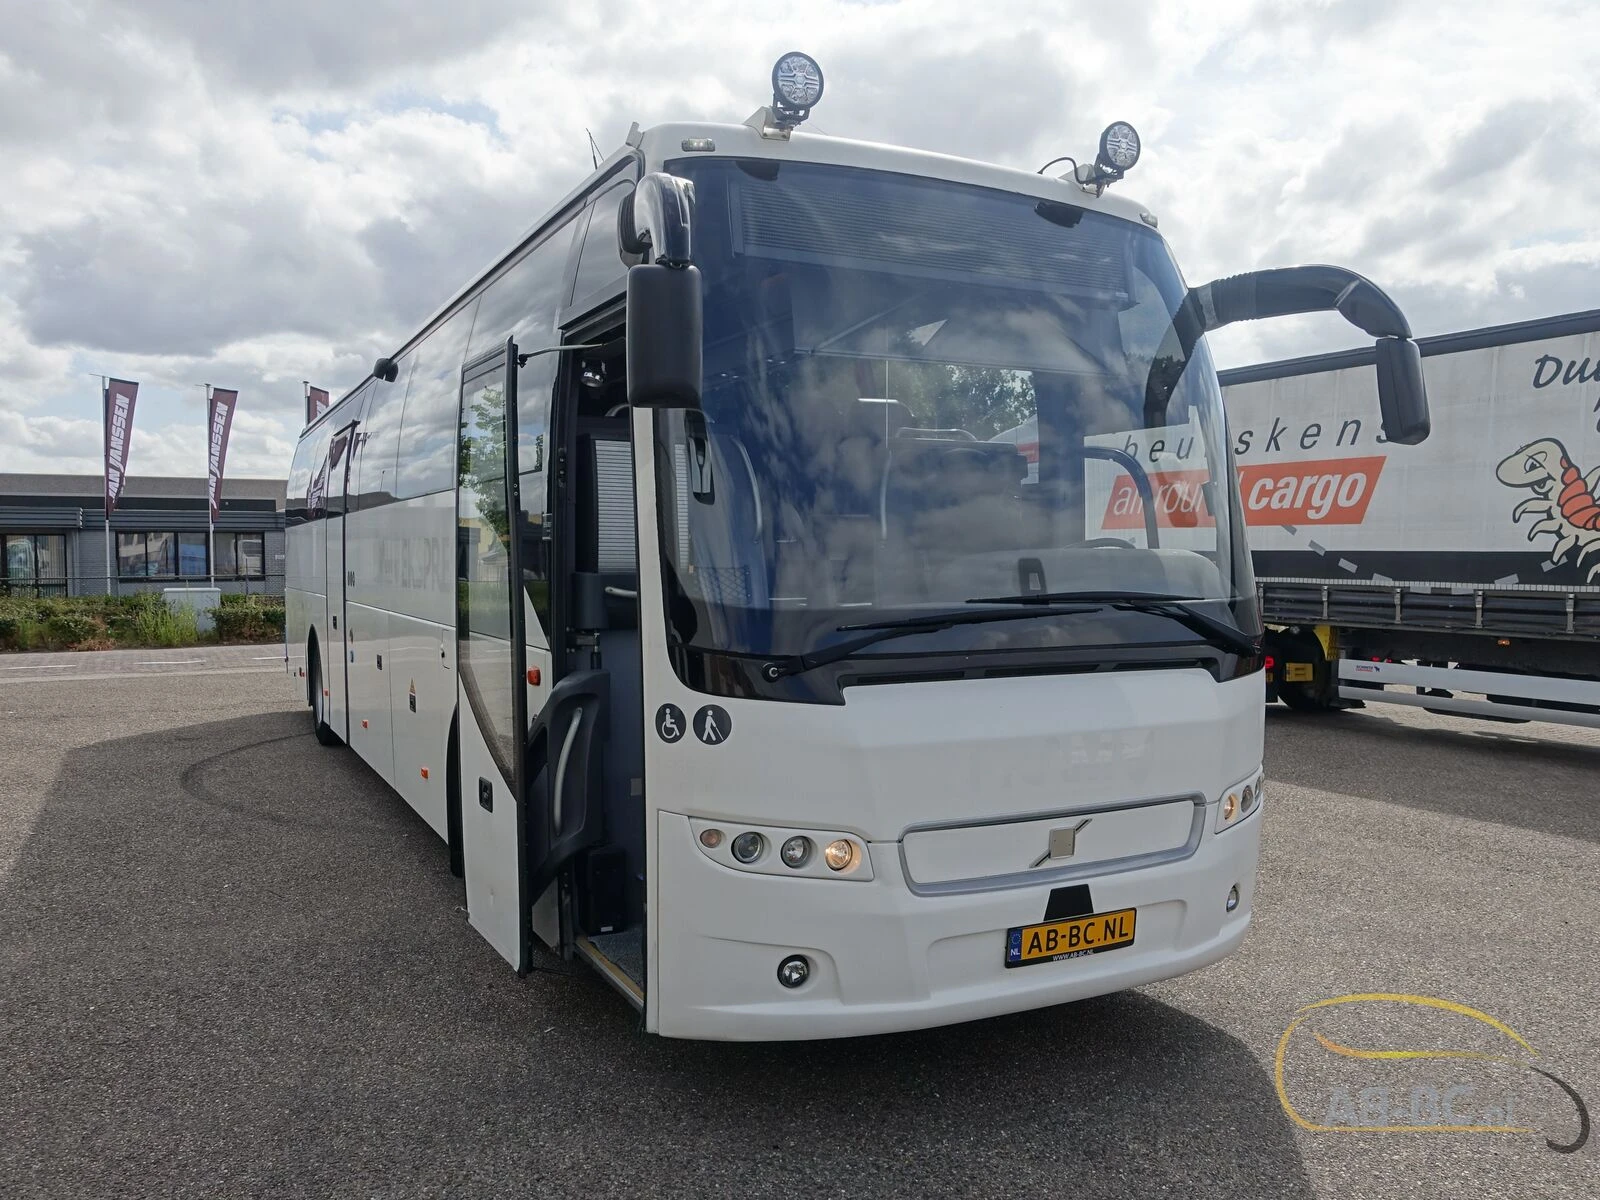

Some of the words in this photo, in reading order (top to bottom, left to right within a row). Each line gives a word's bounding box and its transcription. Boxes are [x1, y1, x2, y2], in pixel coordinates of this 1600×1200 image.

[109, 393, 130, 474] JANSSEN
[209, 401, 229, 479] JANSSEN
[1247, 471, 1368, 520] cargo
[1010, 948, 1021, 957] NL
[1027, 916, 1129, 955] AB-BC.NL
